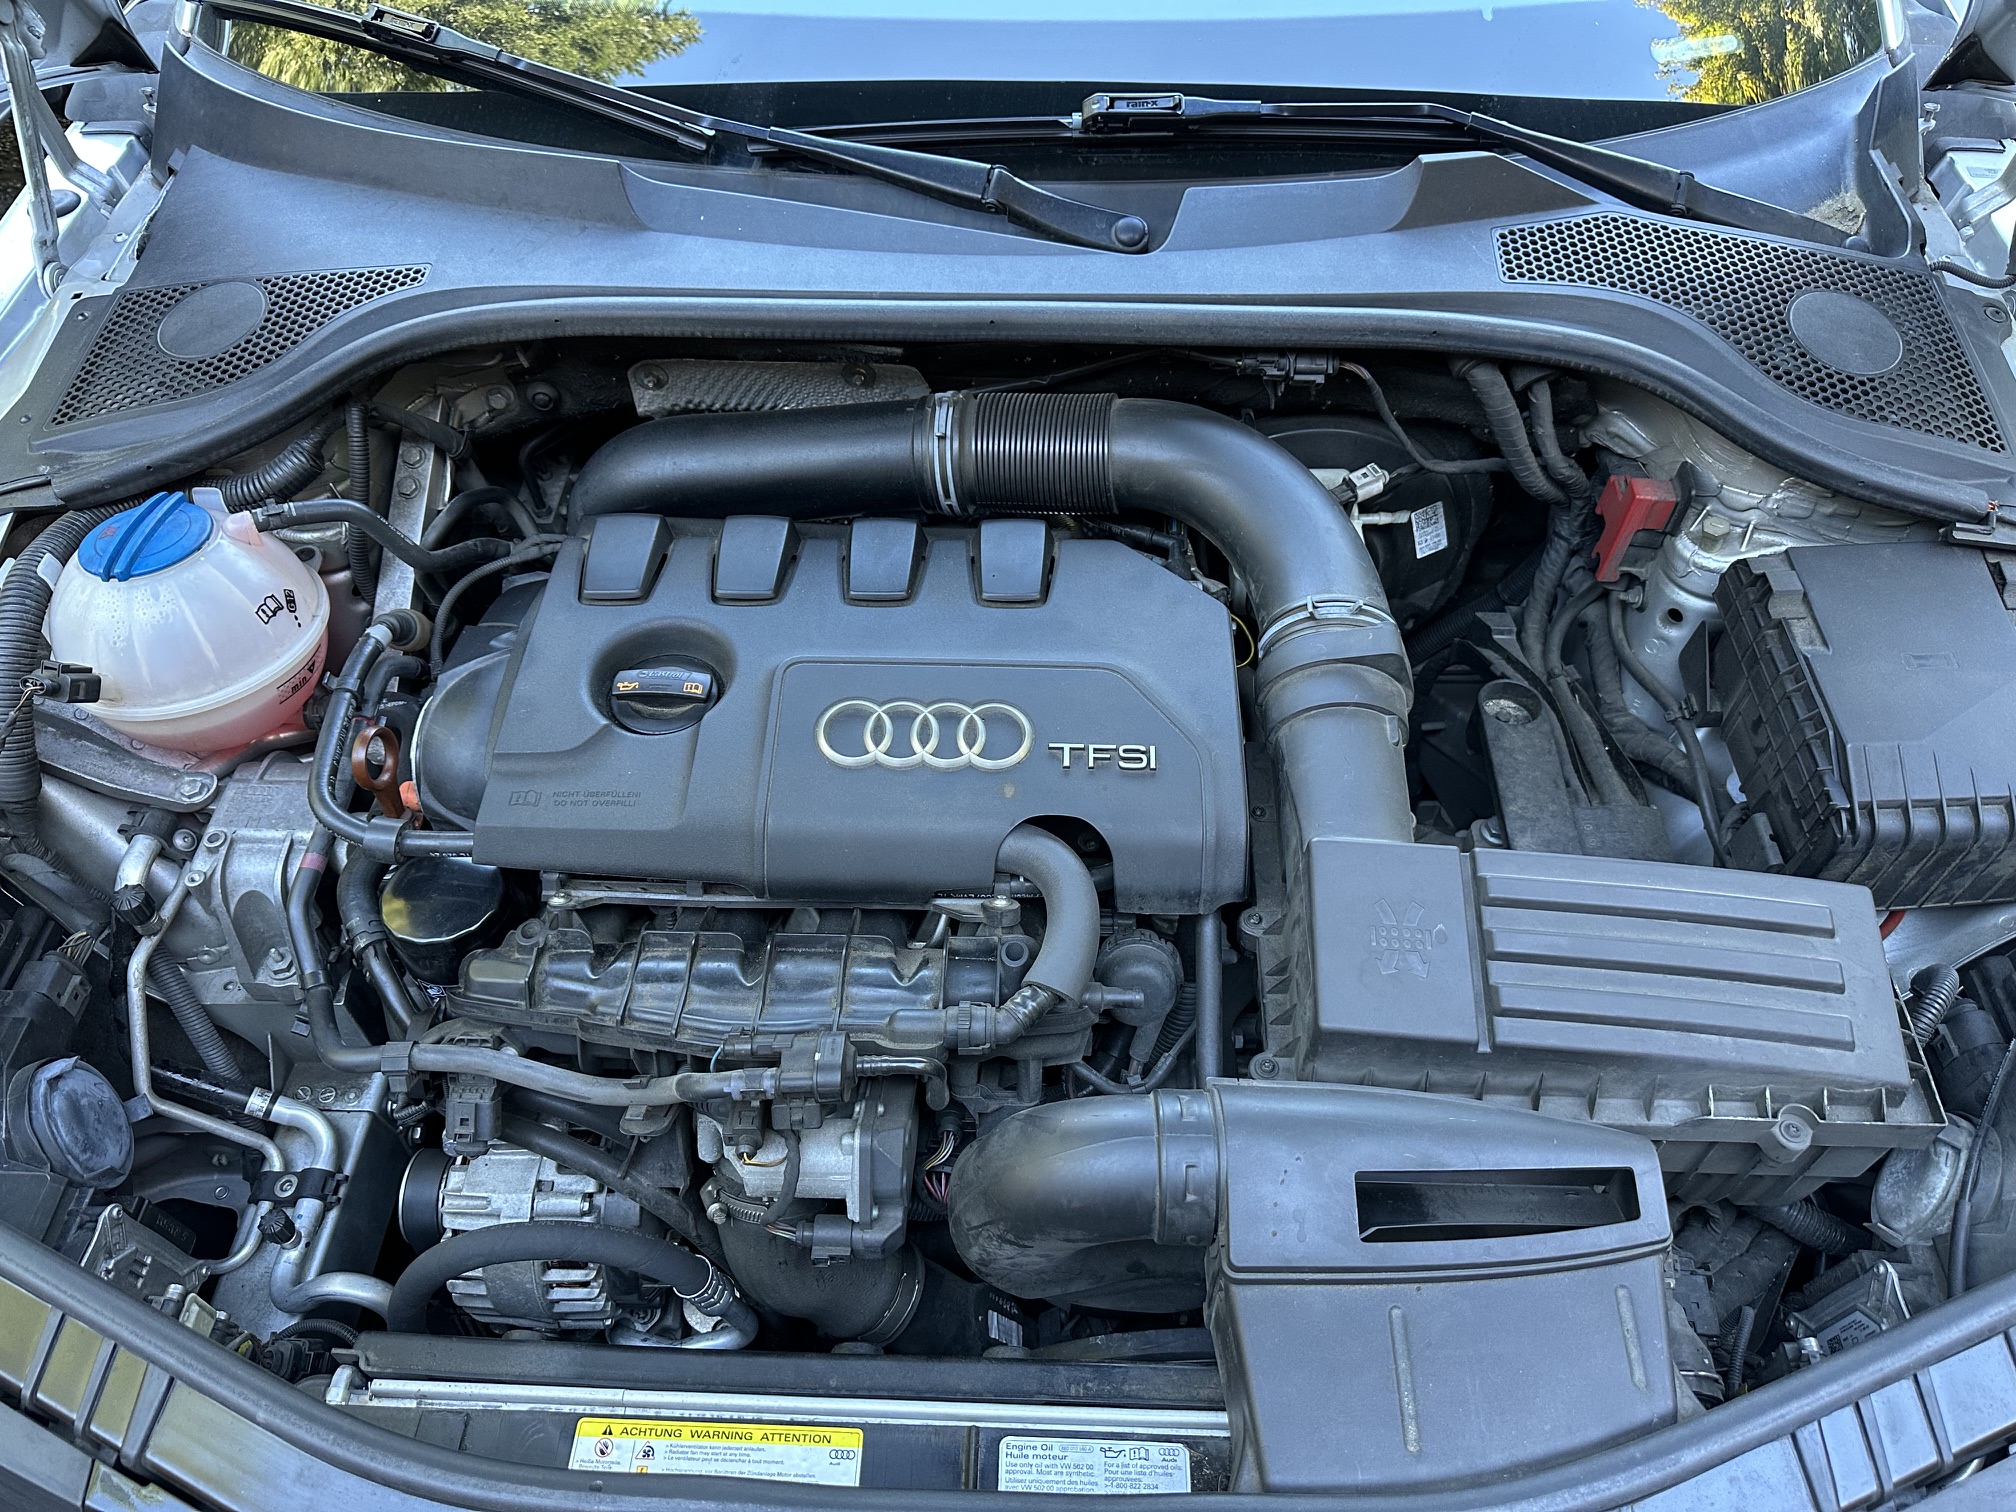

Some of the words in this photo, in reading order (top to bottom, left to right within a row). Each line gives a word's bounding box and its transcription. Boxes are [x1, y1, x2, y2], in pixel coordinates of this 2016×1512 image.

[648, 670, 684, 679] Castrol
[291, 676, 307, 694] min
[1048, 742, 1157, 771] TFSI
[552, 790, 580, 798] NICHT
[619, 1426, 682, 1438] ACHTUNG
[690, 1429, 753, 1441] WARNING
[760, 1432, 832, 1444] ATTENTION
[1005, 1442, 1038, 1452] Engine
[1040, 1443, 1054, 1451] Oil
[1005, 1451, 1030, 1460] Huile
[1005, 1460, 1018, 1468] Use
[1019, 1461, 1033, 1470] only
[1104, 1460, 1115, 1468] For
[1121, 1461, 1131, 1469] list
[1004, 1468, 1034, 1476] approval.
[1036, 1468, 1053, 1476] Most
[1028, 1477, 1066, 1486] uniquement
[1067, 1478, 1079, 1486] des
[1079, 1479, 1099, 1487] huiles
[1033, 1484, 1046, 1492] 502
